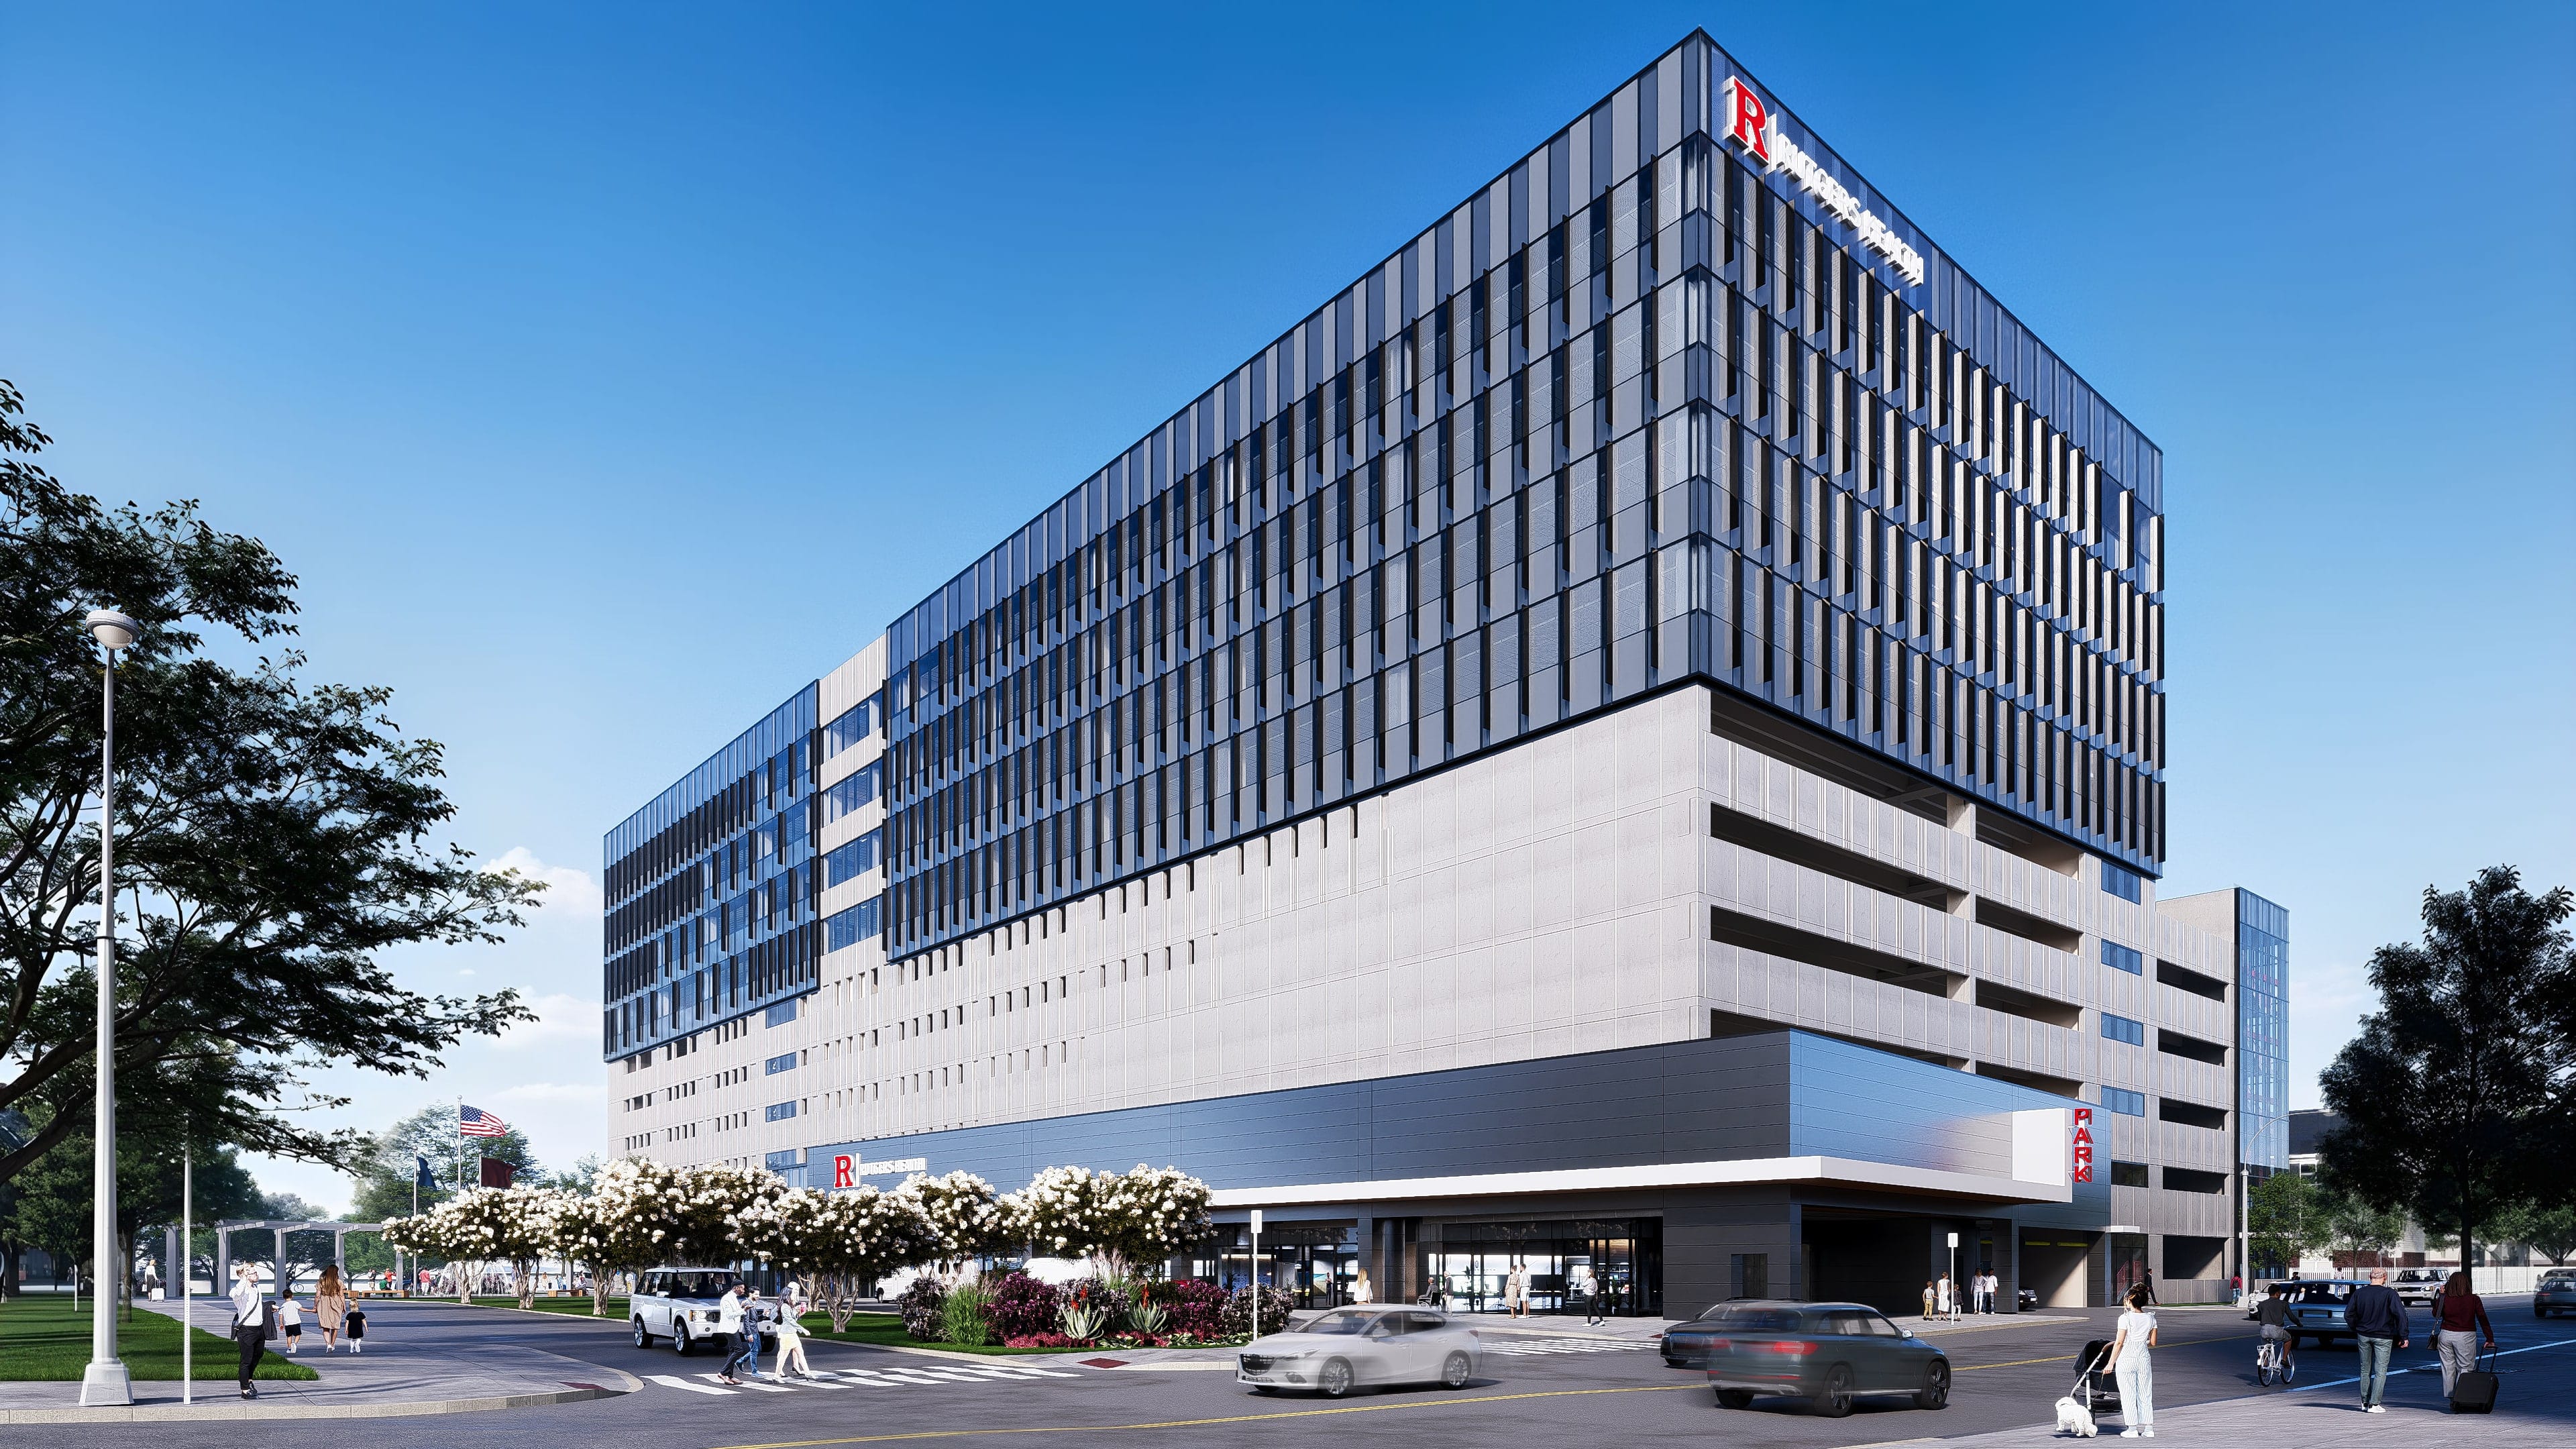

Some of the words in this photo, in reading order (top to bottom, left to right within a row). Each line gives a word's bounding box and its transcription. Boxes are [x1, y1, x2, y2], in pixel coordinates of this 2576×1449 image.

[1725, 75, 1770, 166] R
[834, 1155, 856, 1189] R
[2073, 1108, 2094, 1183] PARK
